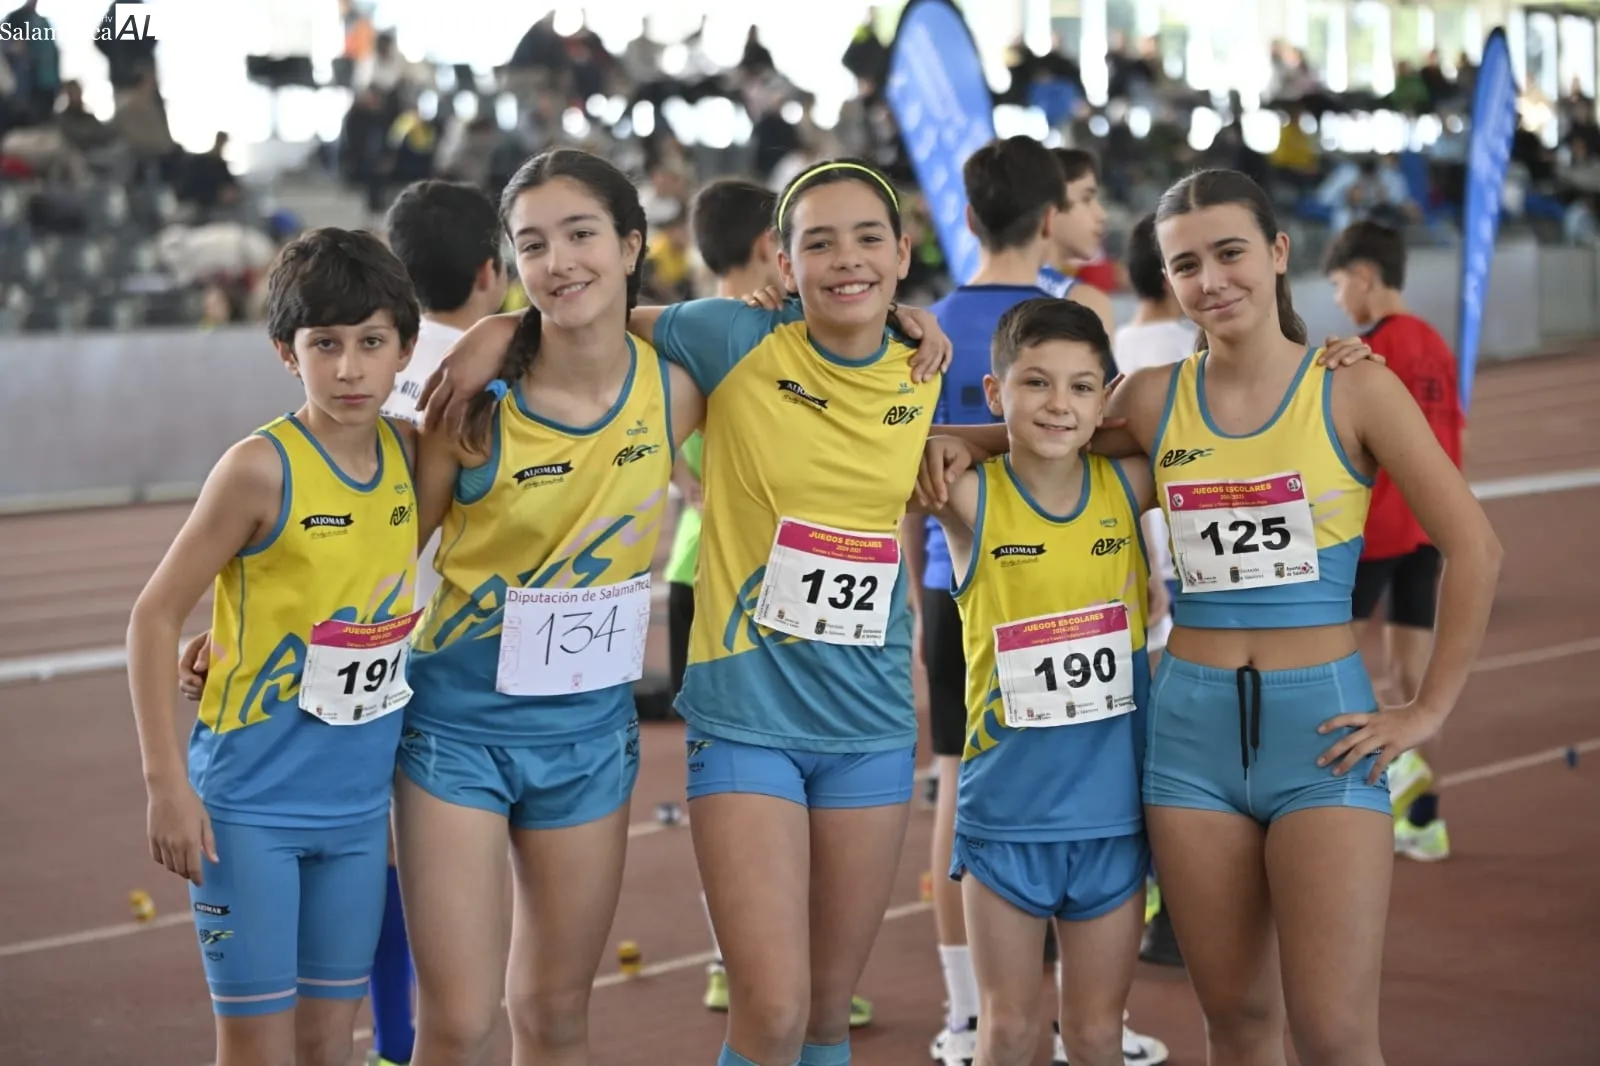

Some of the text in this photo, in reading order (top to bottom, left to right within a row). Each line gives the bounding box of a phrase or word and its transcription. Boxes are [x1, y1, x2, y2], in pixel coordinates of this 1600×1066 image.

[1191, 482, 1272, 495] JUEGOS ESCOLARES
[309, 516, 346, 525] ALJOMAR
[808, 530, 844, 545] JUEGOS
[1200, 516, 1292, 556] 125
[999, 545, 1038, 555] ALJOMAR
[508, 590, 579, 606] Diputación
[582, 590, 597, 602] de
[801, 568, 878, 611] 132
[1022, 612, 1105, 633] JUEGOS ESCOLARES
[535, 604, 627, 666] 134
[337, 648, 402, 695] 191
[1033, 647, 1117, 692] 190
